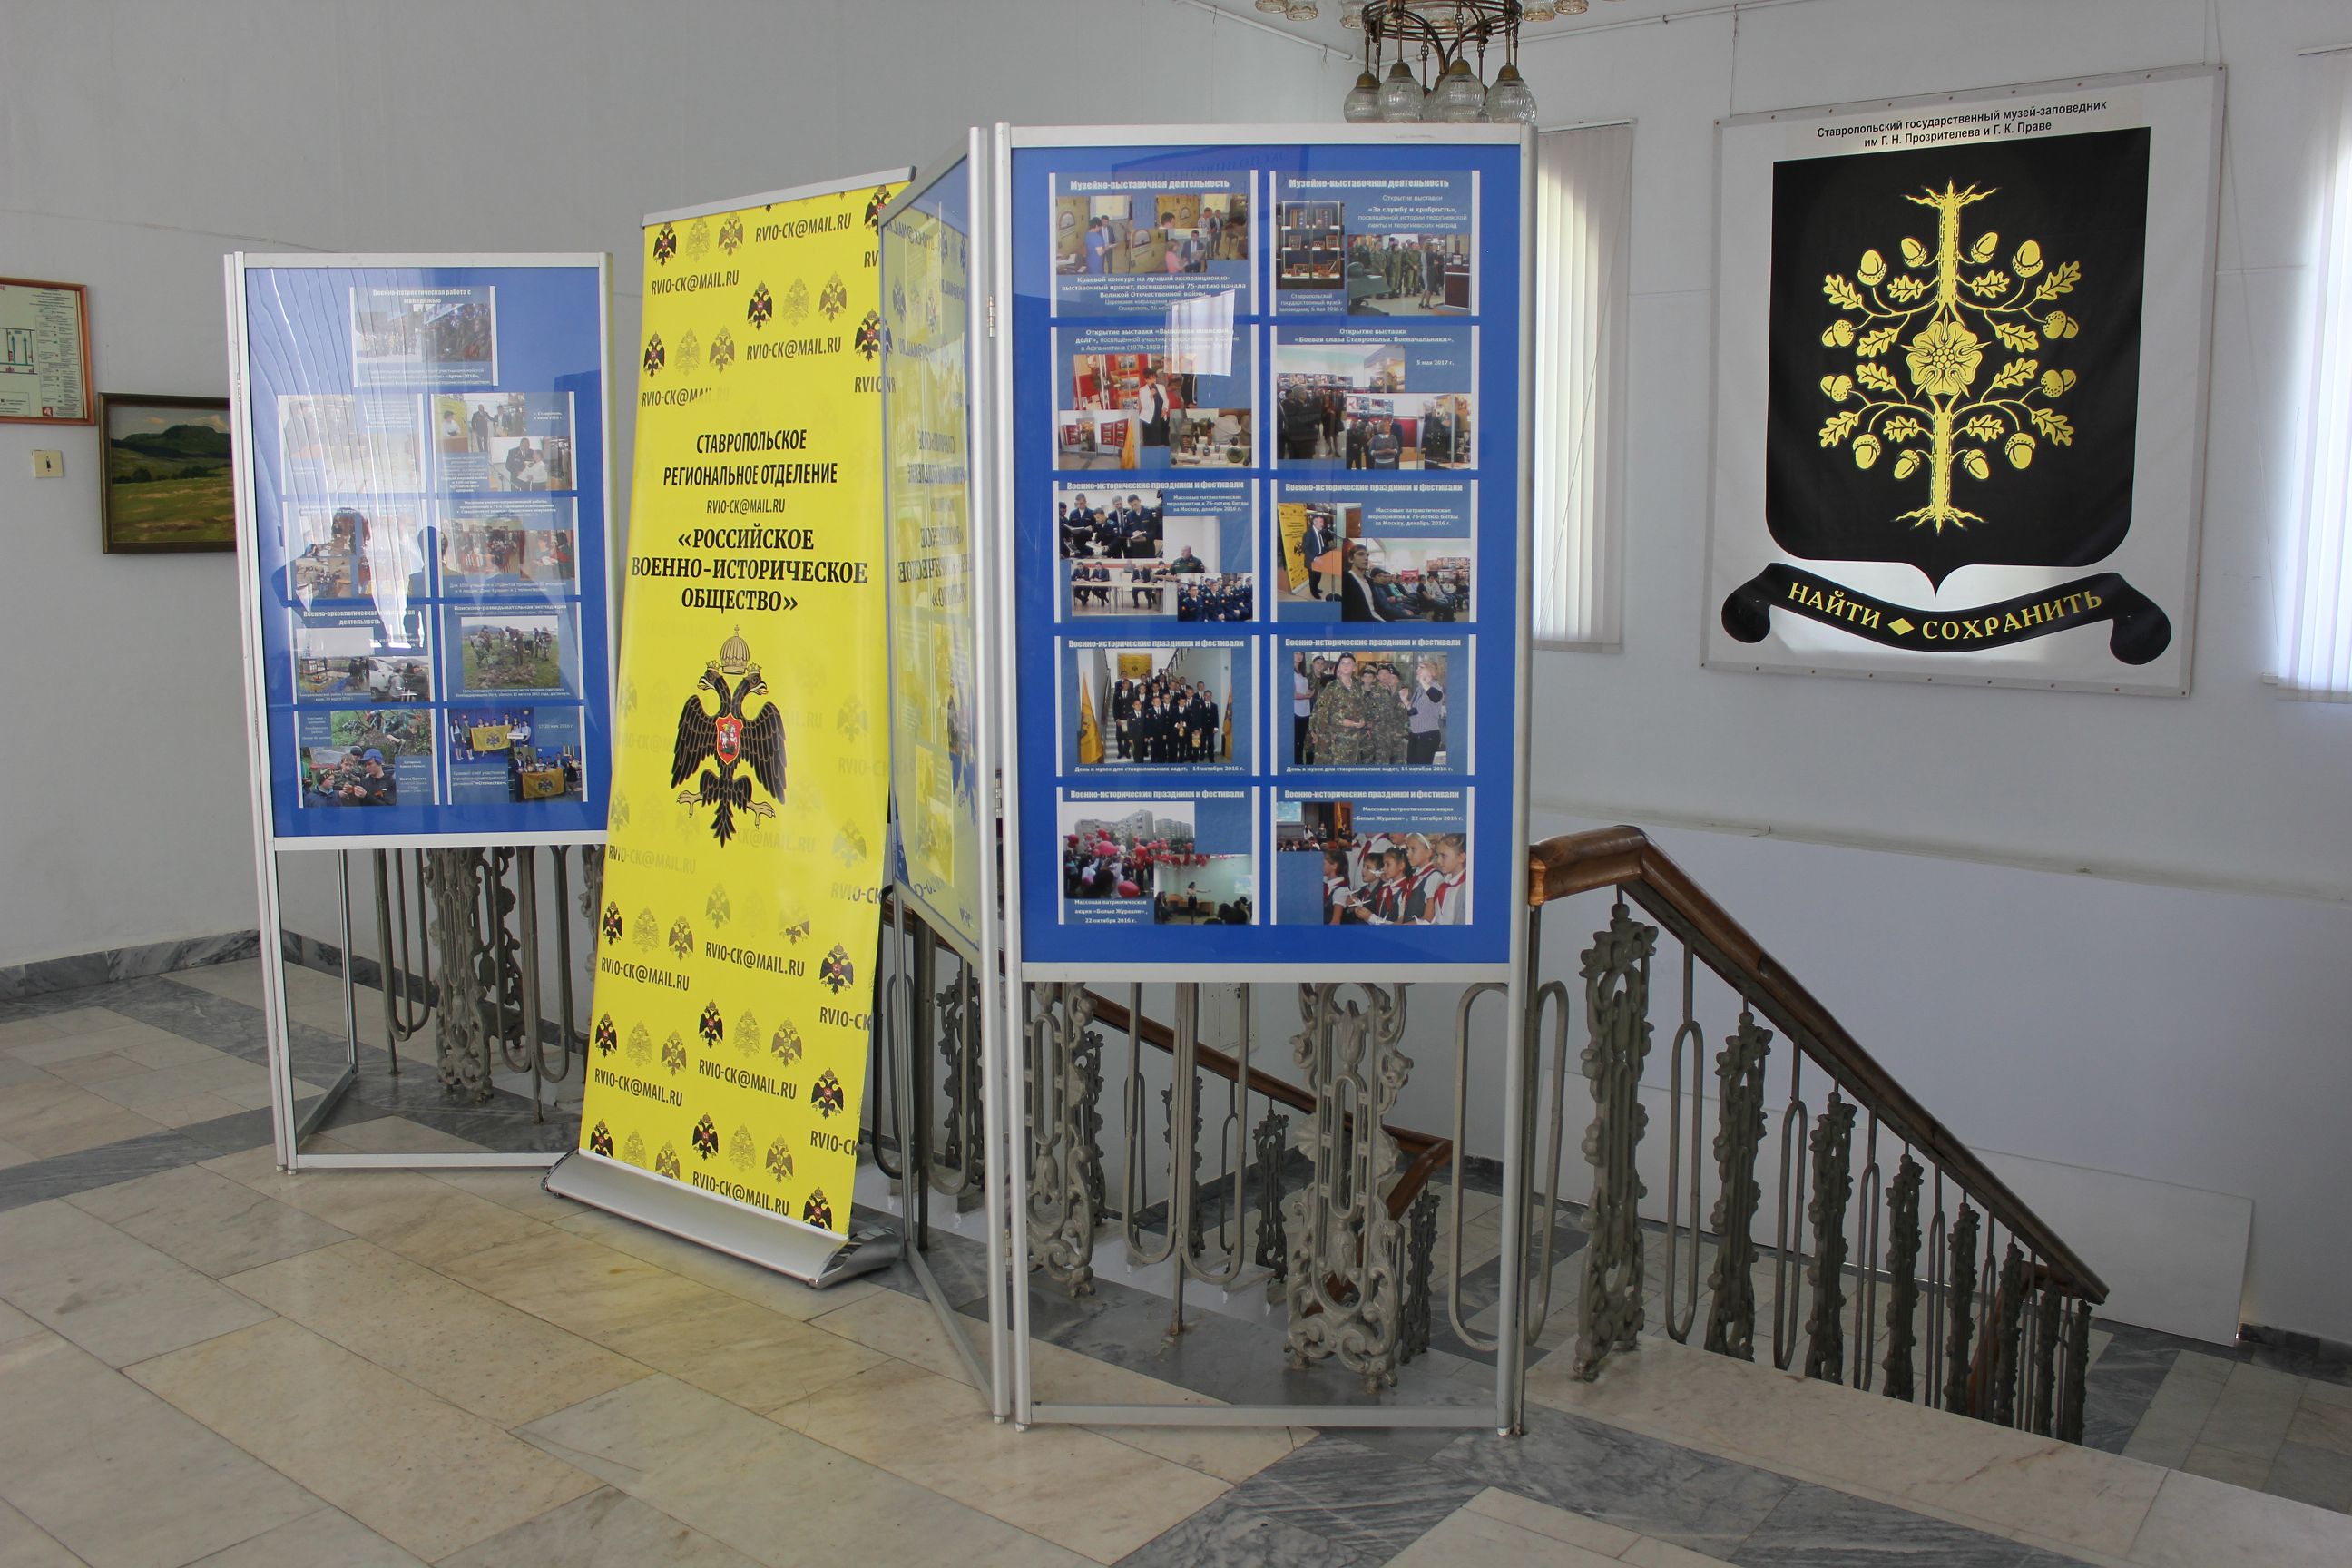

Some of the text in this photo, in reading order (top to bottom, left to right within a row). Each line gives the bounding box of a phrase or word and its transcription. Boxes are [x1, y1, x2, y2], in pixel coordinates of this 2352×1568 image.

[1818, 100, 2107, 138] Ставропольский государственный музей-заповедник
[1864, 120, 2051, 147] им Г. Н. Прозрителева и Г. К. Праве
[1071, 179, 1230, 191] Музейно-выставочная деятельность
[1289, 179, 1449, 189] Музейно-выставочная деятельность
[756, 213, 851, 242] RVIO-CK@MAIL.RU
[652, 270, 739, 295] RVIO-CK@MAIL.RU
[747, 337, 841, 360] RVIO-CK@MAIL.RU
[696, 429, 807, 453] СТАВРОПОЛЬСКОЕ
[663, 463, 838, 487] РЕГИОНАЛЬНОЕ ОТДЕЛЕНИЕ
[707, 499, 785, 514] RVIO-CK@MAIL.RU
[678, 523, 814, 549] «РОССИЙСКОЕ
[632, 557, 868, 583] ВОЕННО-ИСТОРИЧЕСКОЕ
[681, 587, 798, 613] ОБЩЕСТВО»
[1788, 582, 2102, 640] НАЙТИ СОХРАНИТЬ
[706, 942, 805, 977] RVIO-CK@MAIL.RU
[601, 957, 690, 991] RVIO-CK@MAIL.RU
[595, 1068, 683, 1107] RVIO-CK@MAIL.RU
[699, 1059, 796, 1099] RVIO-CK@MAIL.RU
[693, 1171, 789, 1216] RVIO-CK@MAIL.RU
